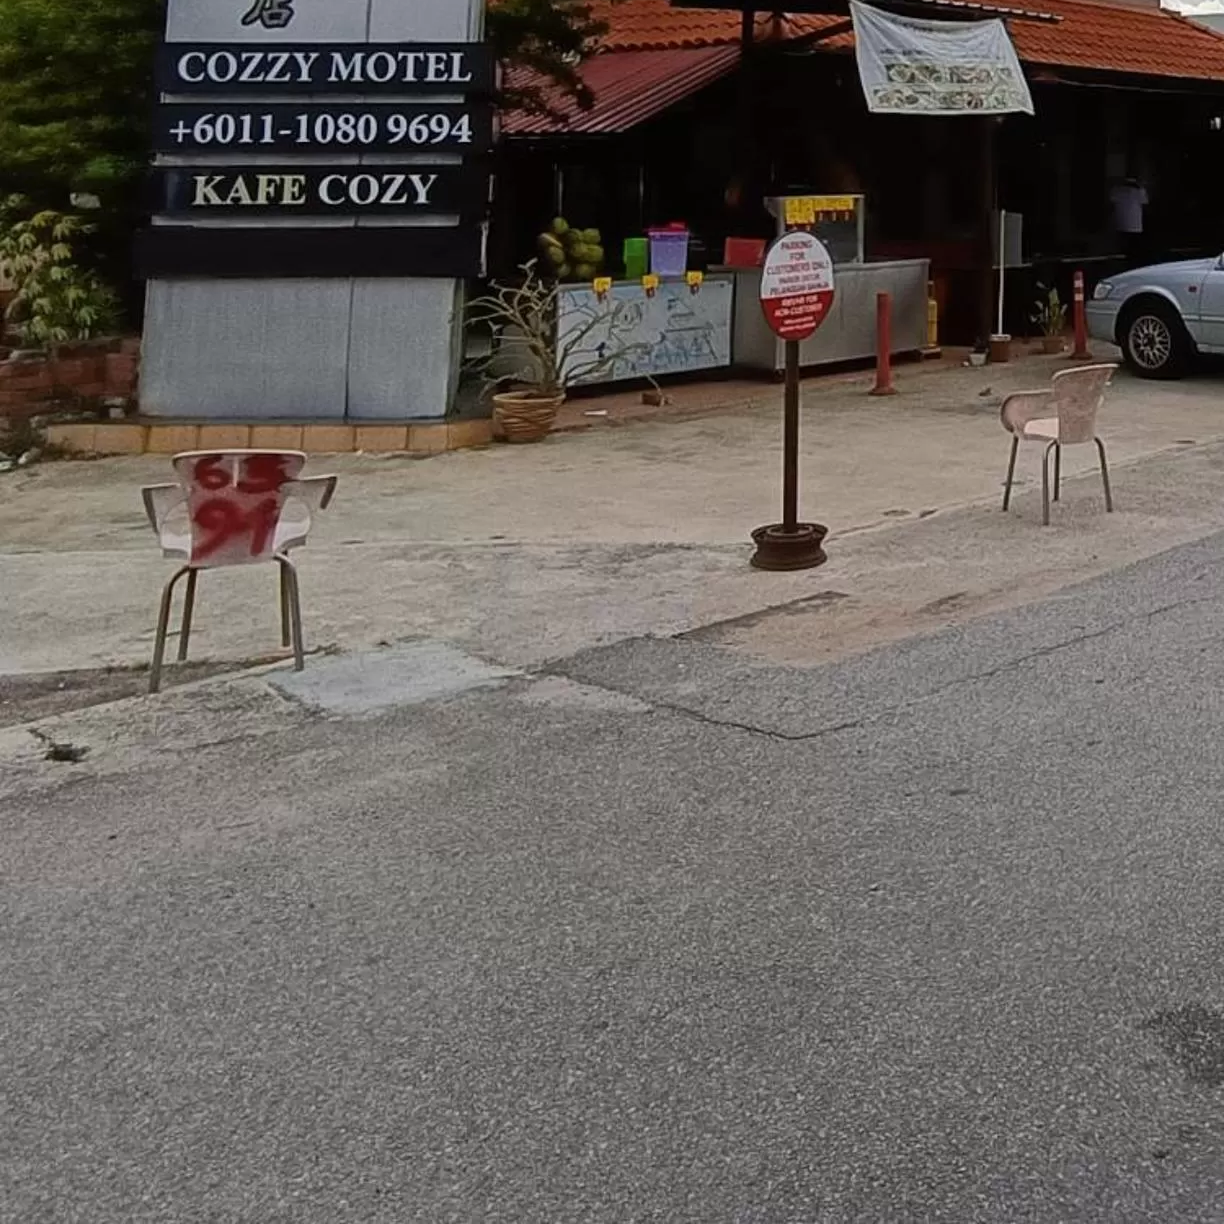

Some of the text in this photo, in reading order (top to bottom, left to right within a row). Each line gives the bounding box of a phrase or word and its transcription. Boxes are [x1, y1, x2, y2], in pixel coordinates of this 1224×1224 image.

[177, 51, 472, 83] COZZY MOTEL
[169, 113, 473, 144] +6011-1080 9694
[192, 174, 438, 205] KAFE COZY
